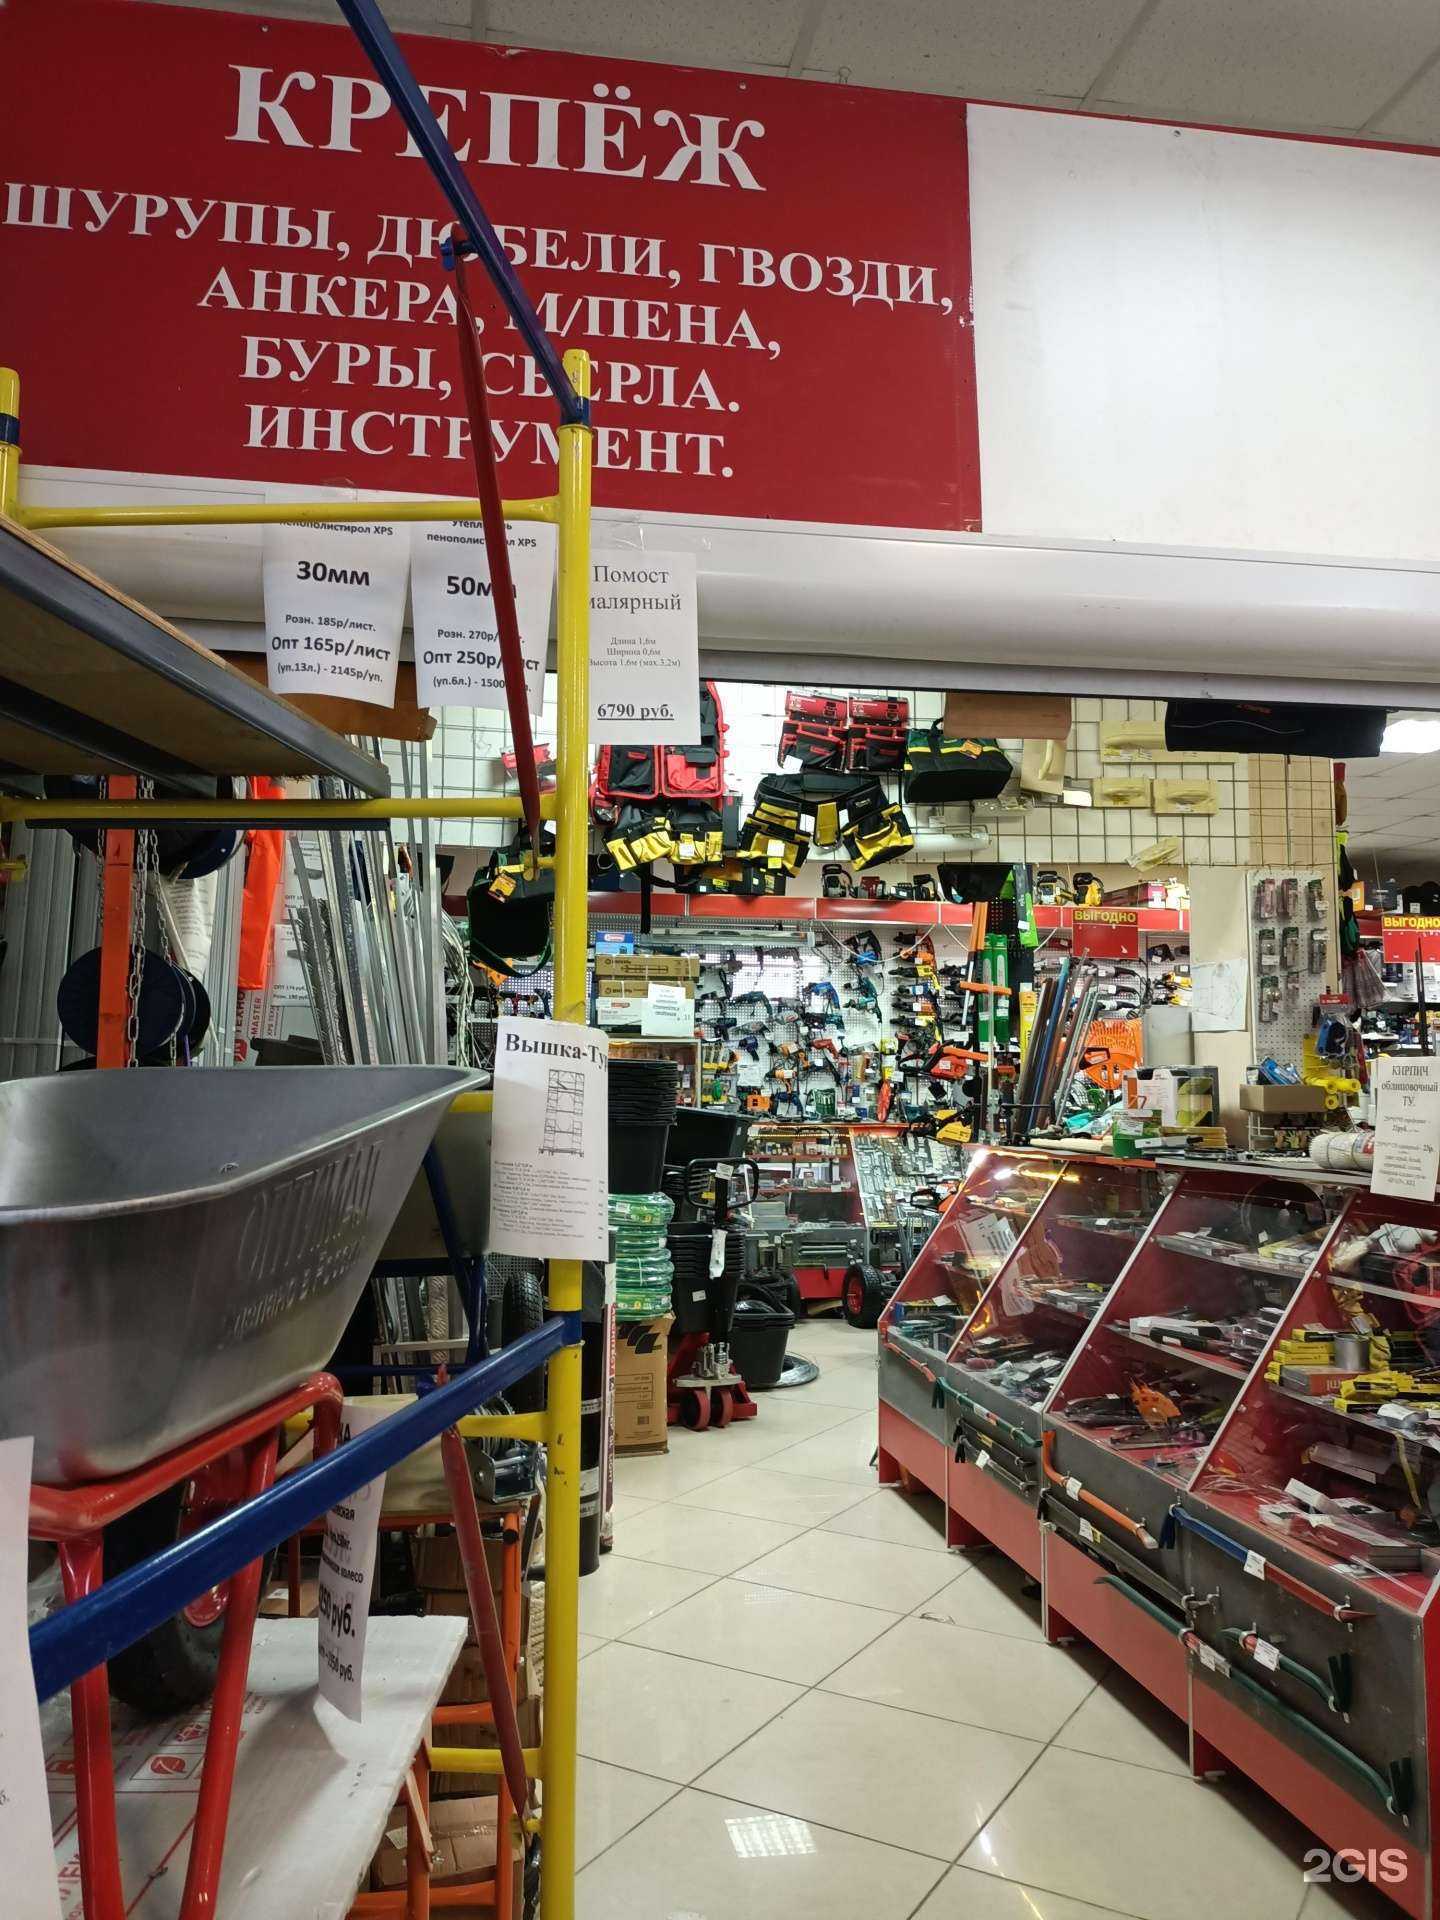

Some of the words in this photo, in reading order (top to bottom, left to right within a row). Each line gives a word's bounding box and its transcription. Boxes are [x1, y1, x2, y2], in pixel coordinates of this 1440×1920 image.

[4, 182, 350, 261] ШУРУПЫ,
[367, 214, 680, 288] ДЮБЕЛИ,
[699, 243, 954, 315] ГВОЗДИ,
[197, 267, 485, 335] АНКЕРА,
[239, 336, 452, 400] БУРЫ,
[482, 352, 741, 413] СВРЛА.
[373, 526, 394, 536] XPS
[518, 539, 537, 547] XPS
[297, 560, 370, 587] 30мм
[593, 565, 669, 583] Помост
[285, 614, 314, 625] Розн.
[318, 616, 376, 632] 185р/лист.
[437, 629, 466, 639] Розн.
[272, 636, 299, 650] Опт
[304, 637, 391, 661] 165р/лист
[610, 637, 637, 647] Длина
[423, 651, 452, 664] Опт
[277, 662, 321, 674] (уп.13л.)
[330, 665, 383, 683] 2145р/уп.
[433, 676, 471, 688] (уп.6л.)
[597, 704, 635, 719] 6790
[640, 704, 674, 720] руб.
[1074, 911, 1136, 923] ВЫГОДНО
[1384, 917, 1440, 928] ВЫГОДНО
[1392, 1065, 1429, 1077] КИРПИЧ
[1381, 1081, 1438, 1092] облицовочный
[331, 1602, 355, 1637] руб.
